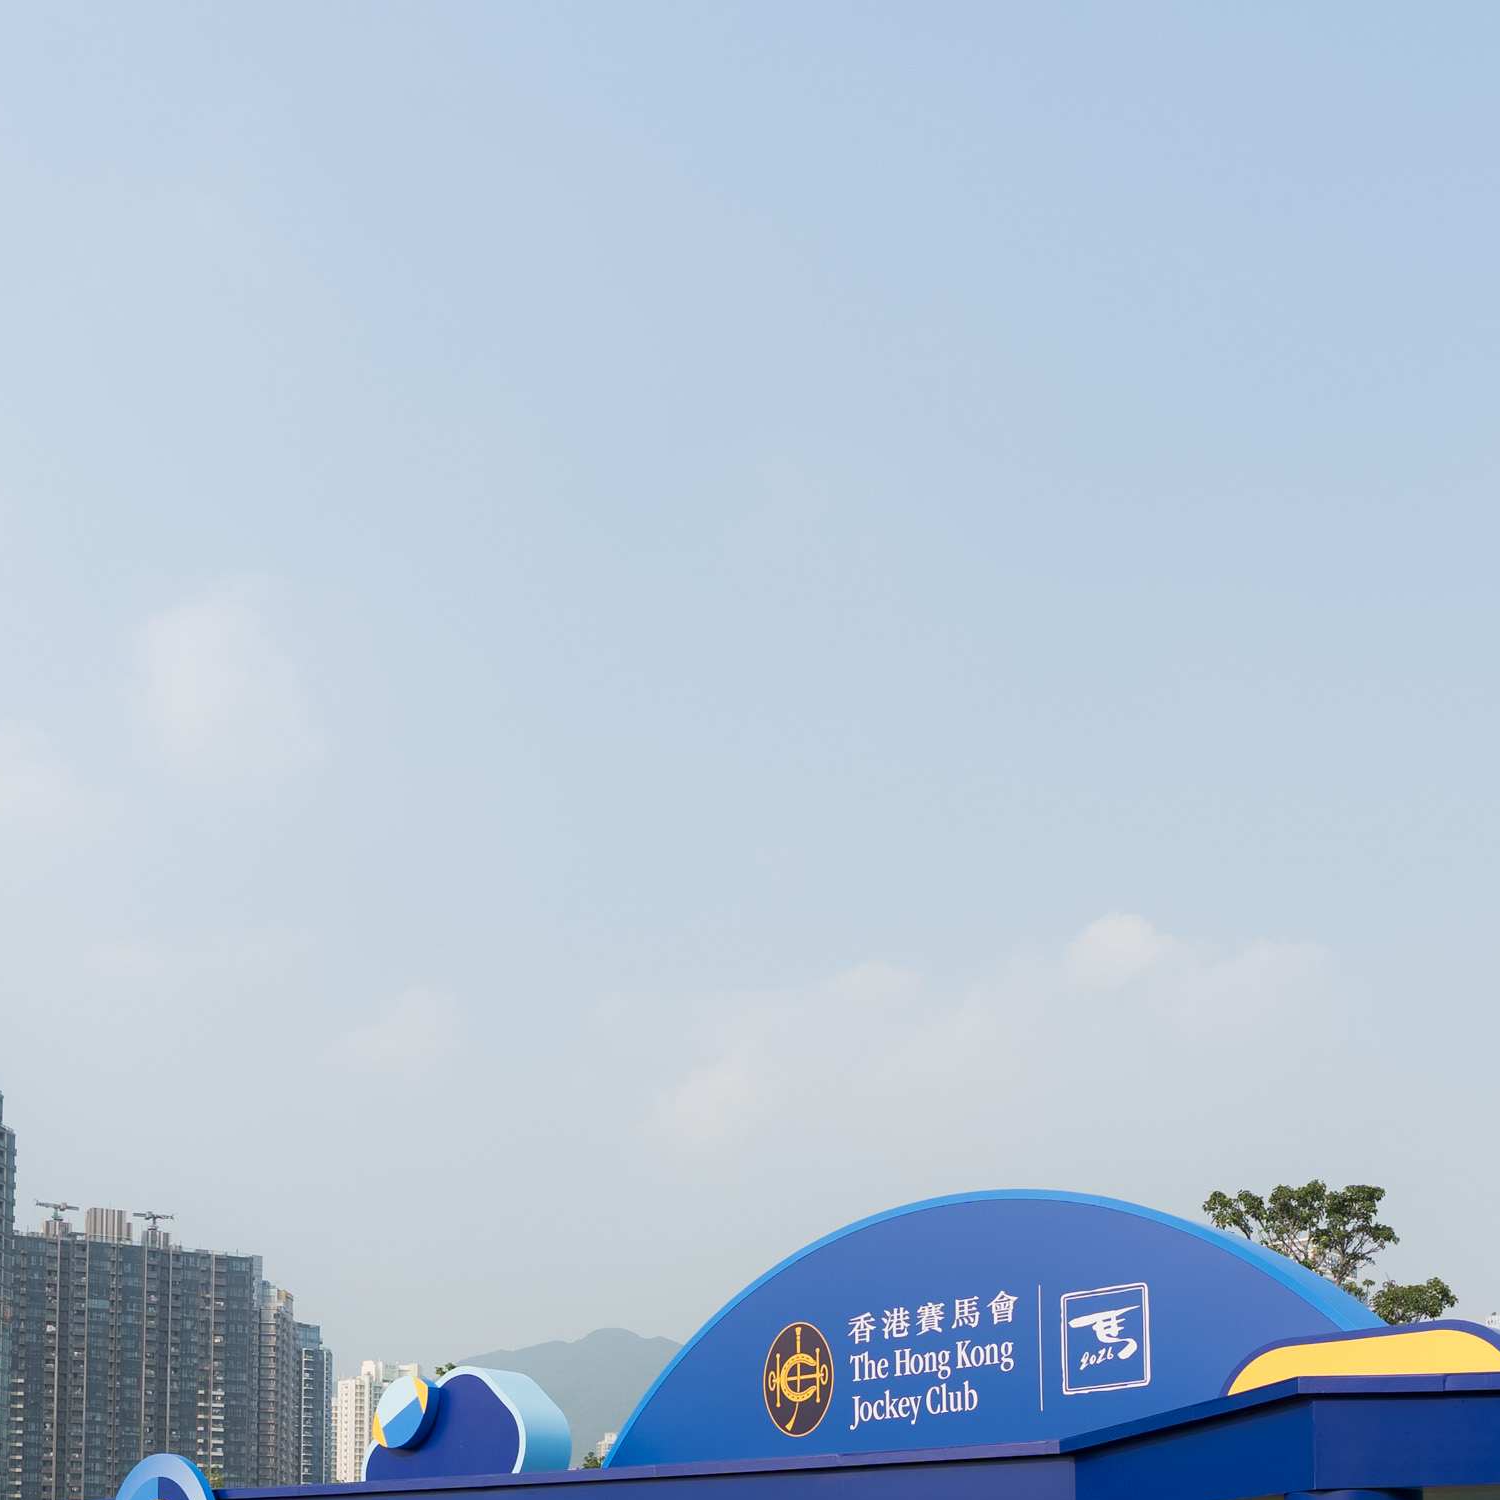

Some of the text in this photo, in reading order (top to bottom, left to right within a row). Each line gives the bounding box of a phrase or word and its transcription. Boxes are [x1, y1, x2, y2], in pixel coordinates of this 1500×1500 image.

[847, 1290, 1019, 1345] 香港賽馬會
[849, 1339, 1015, 1382] The Hong Kong
[1079, 1346, 1115, 1371] 2026
[849, 1380, 979, 1431] Jockey Club
